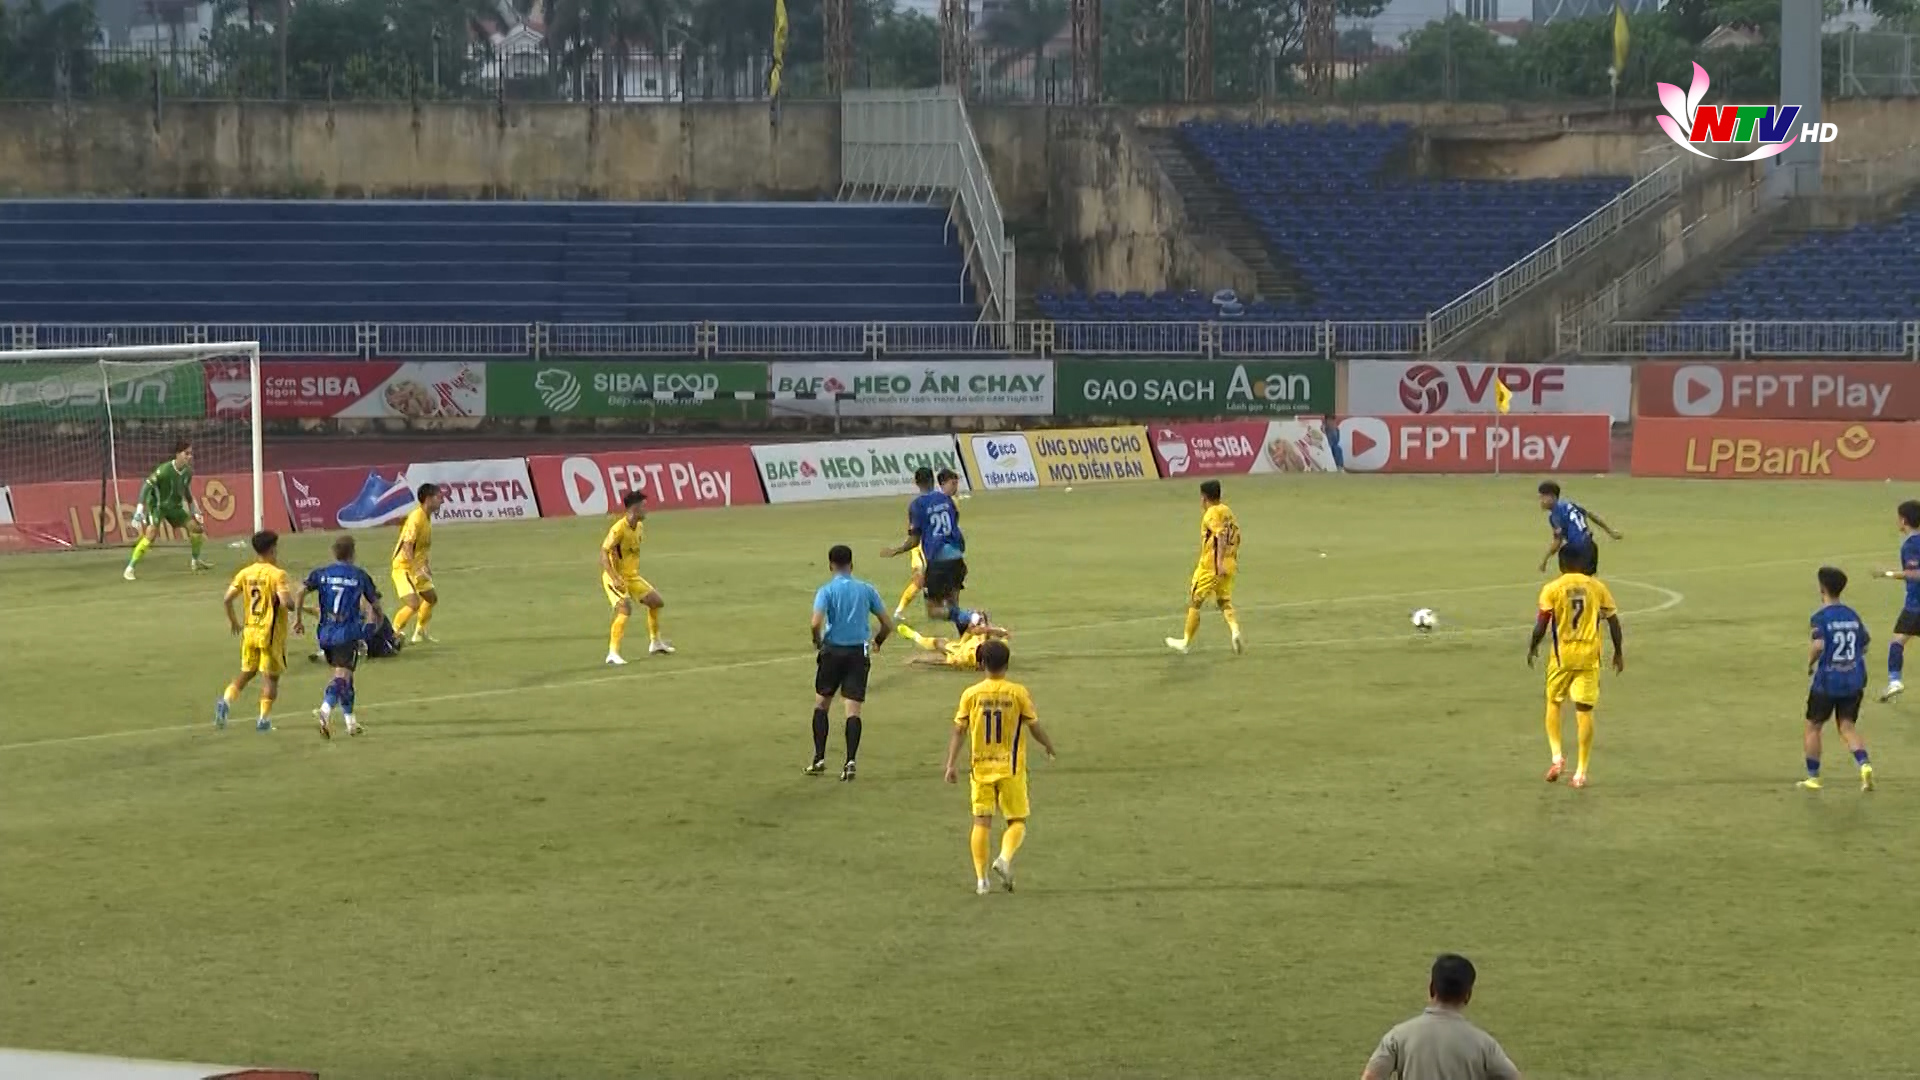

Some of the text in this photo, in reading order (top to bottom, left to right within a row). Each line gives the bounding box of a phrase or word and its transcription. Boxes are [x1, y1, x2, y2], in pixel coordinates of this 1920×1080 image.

[301, 377, 360, 396] SIBA
[594, 373, 719, 392] SIBA FOOD
[778, 377, 824, 393] BAF
[854, 368, 1045, 394] HEO ĂN CHAY
[1083, 379, 1214, 406] GẠO SẠCH
[1456, 365, 1565, 405] VPF
[1732, 375, 1892, 416] FPT Play
[1036, 435, 1141, 461] ỨNG DỤNG CHO
[1214, 435, 1254, 457] SIBA
[1400, 427, 1571, 469] FPT Play
[1686, 437, 1834, 474] LPBank
[766, 461, 798, 480] BAF
[820, 448, 957, 480] HEO ĂN CHAY
[1049, 456, 1144, 484] MỌI ĐIỂM BÁN
[437, 479, 528, 503] RTISTA
[608, 462, 731, 506] FPT Play
[434, 504, 483, 519] KAMITO
[930, 511, 951, 536] 29
[251, 588, 262, 616] 2
[331, 585, 345, 614] 7
[1572, 598, 1584, 630] 7
[1832, 631, 1857, 661] 23
[982, 709, 1002, 745] 11
